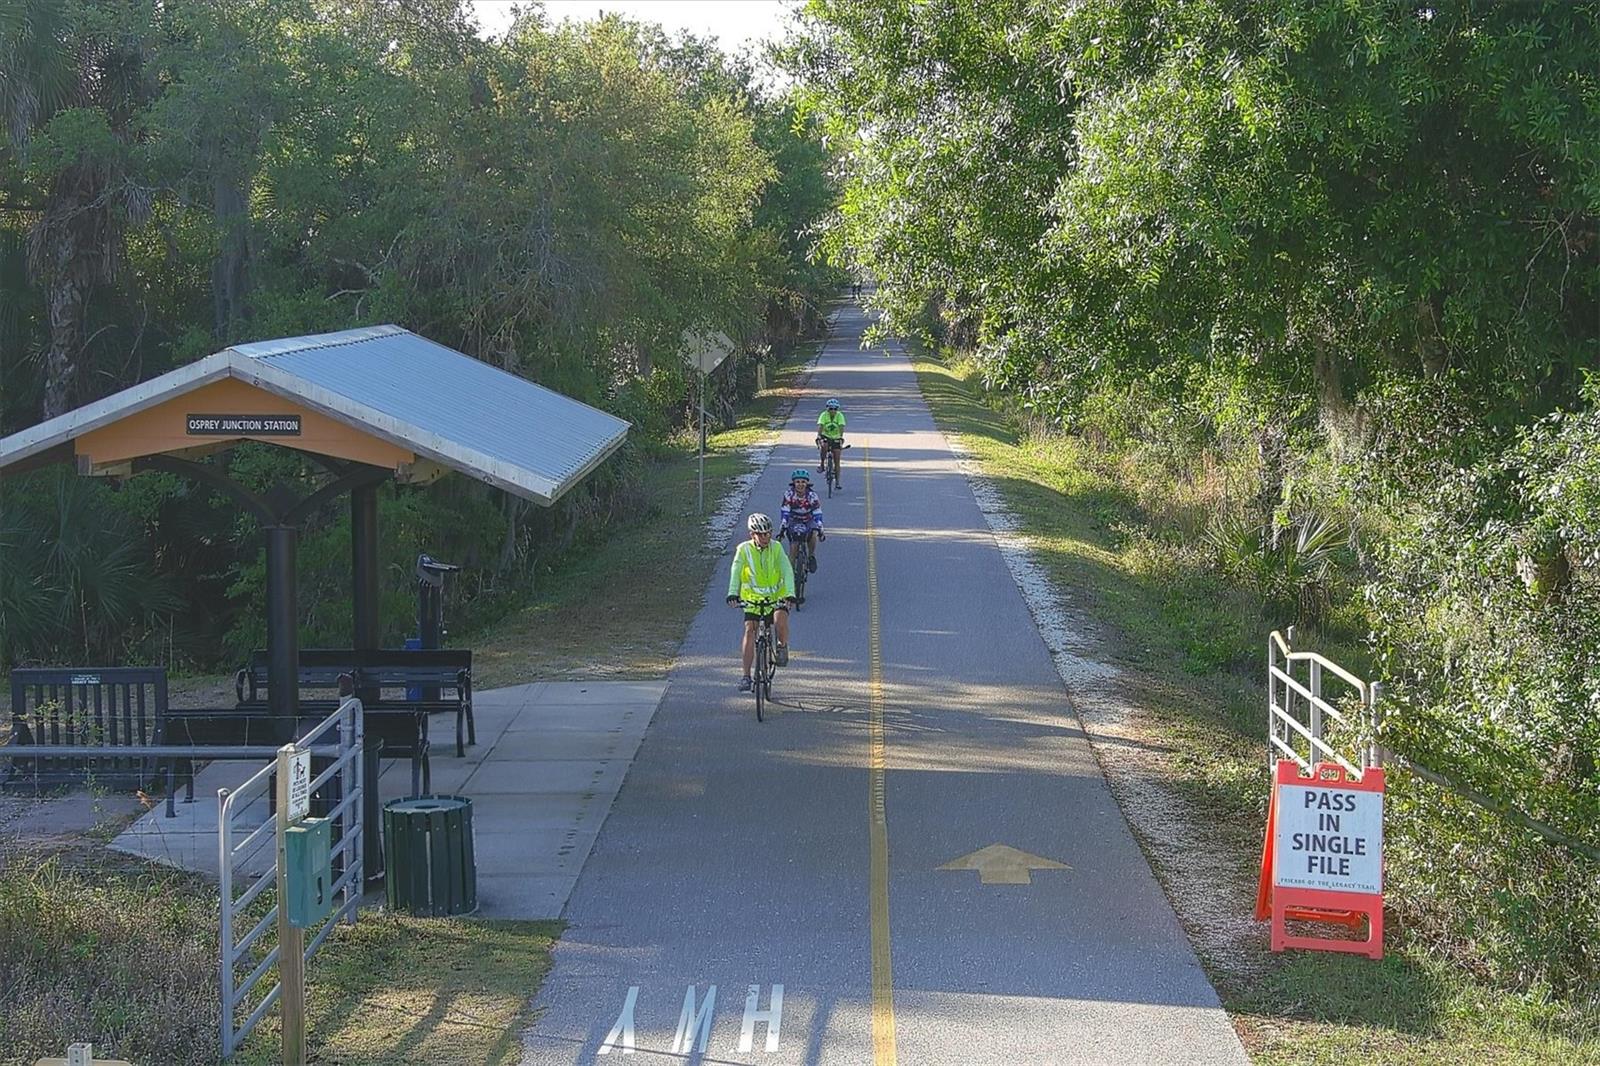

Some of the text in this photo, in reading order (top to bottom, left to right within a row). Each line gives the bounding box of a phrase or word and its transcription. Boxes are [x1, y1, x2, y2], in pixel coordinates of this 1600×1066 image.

[189, 420, 298, 430] OSPREY JUNCTION STATION
[1304, 791, 1356, 811] PASS
[1318, 813, 1340, 832] IN
[1292, 833, 1366, 856] SINGLE
[1308, 856, 1350, 876] FILE
